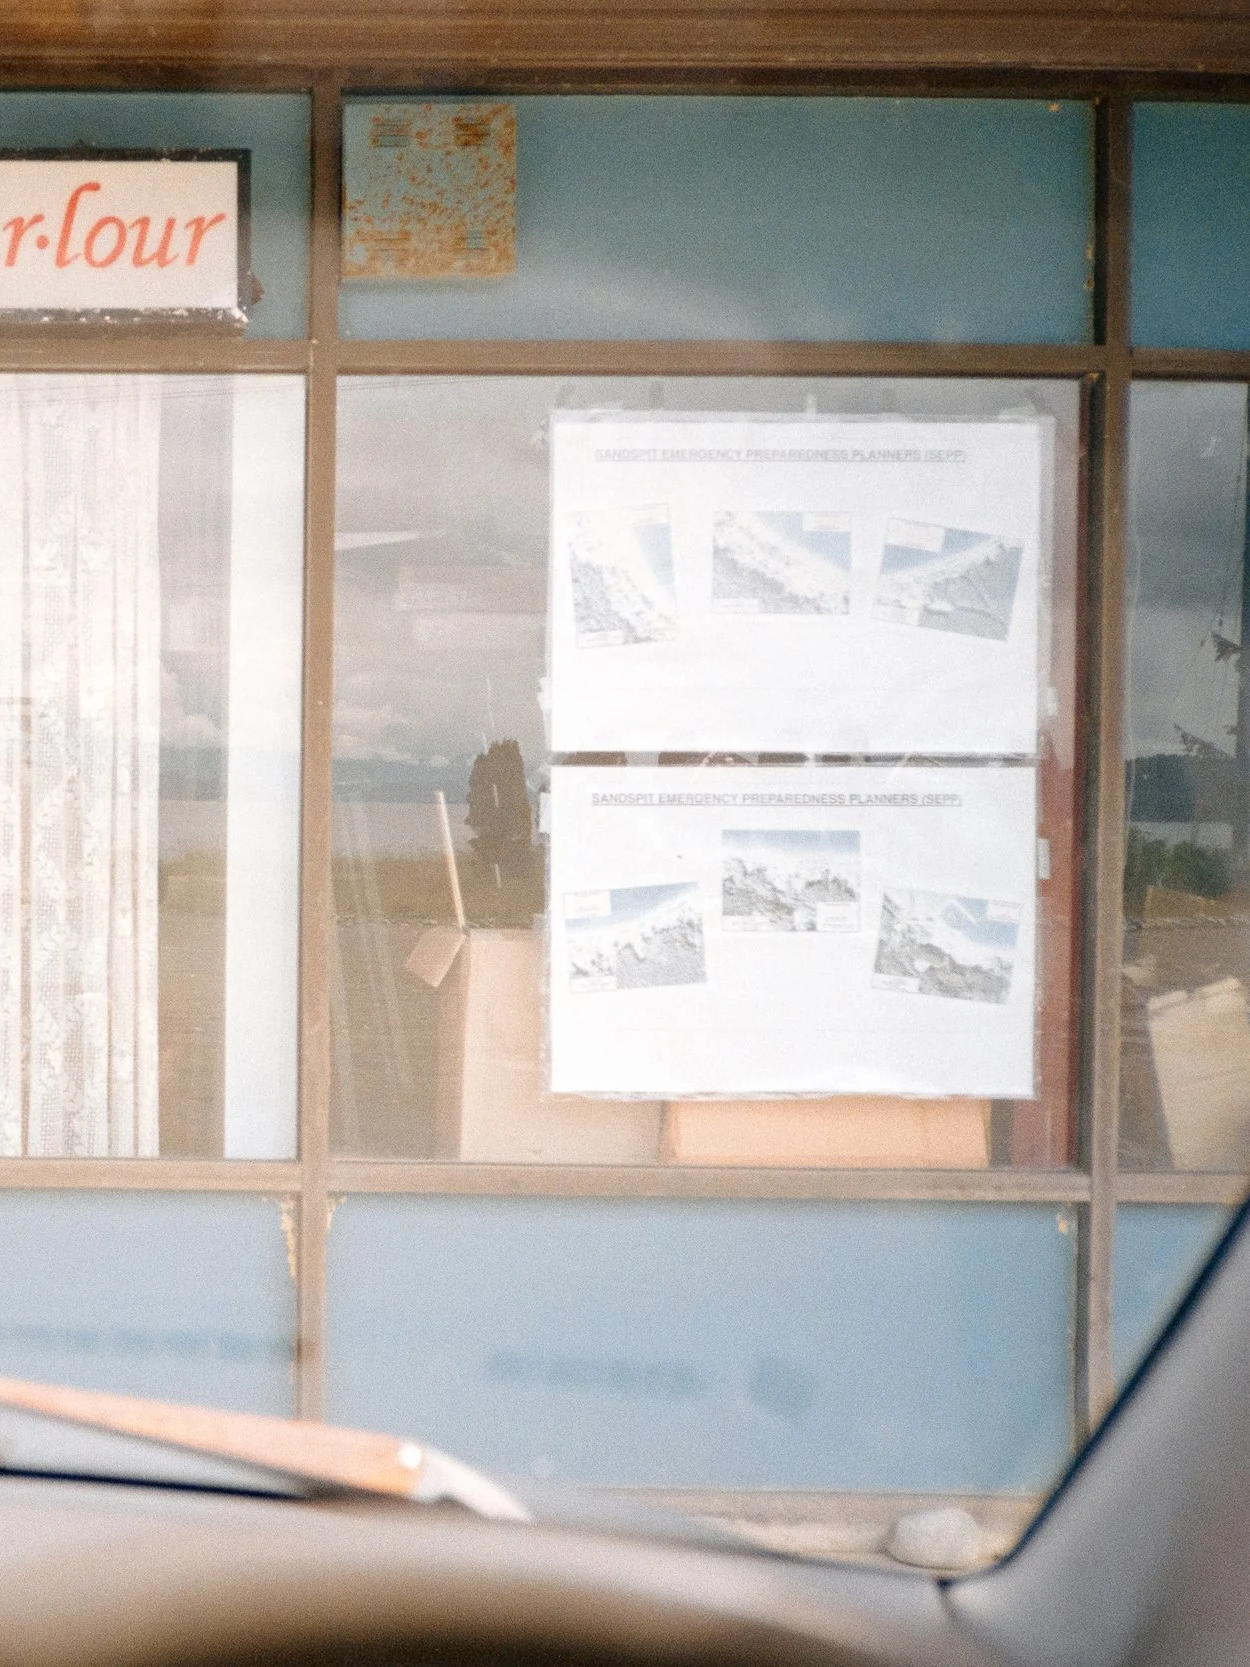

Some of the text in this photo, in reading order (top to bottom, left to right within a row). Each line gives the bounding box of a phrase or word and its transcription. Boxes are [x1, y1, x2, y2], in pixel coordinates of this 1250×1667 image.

[661, 447, 742, 463] EMERGENCY
[746, 447, 849, 463] PREPAREDNESS
[851, 448, 922, 463] PLANNERS
[591, 792, 655, 807] SANDSPIT
[658, 792, 739, 807] EMERGENCY
[742, 792, 846, 807] PREPAREDNESS
[849, 792, 919, 807] PLANNERS
